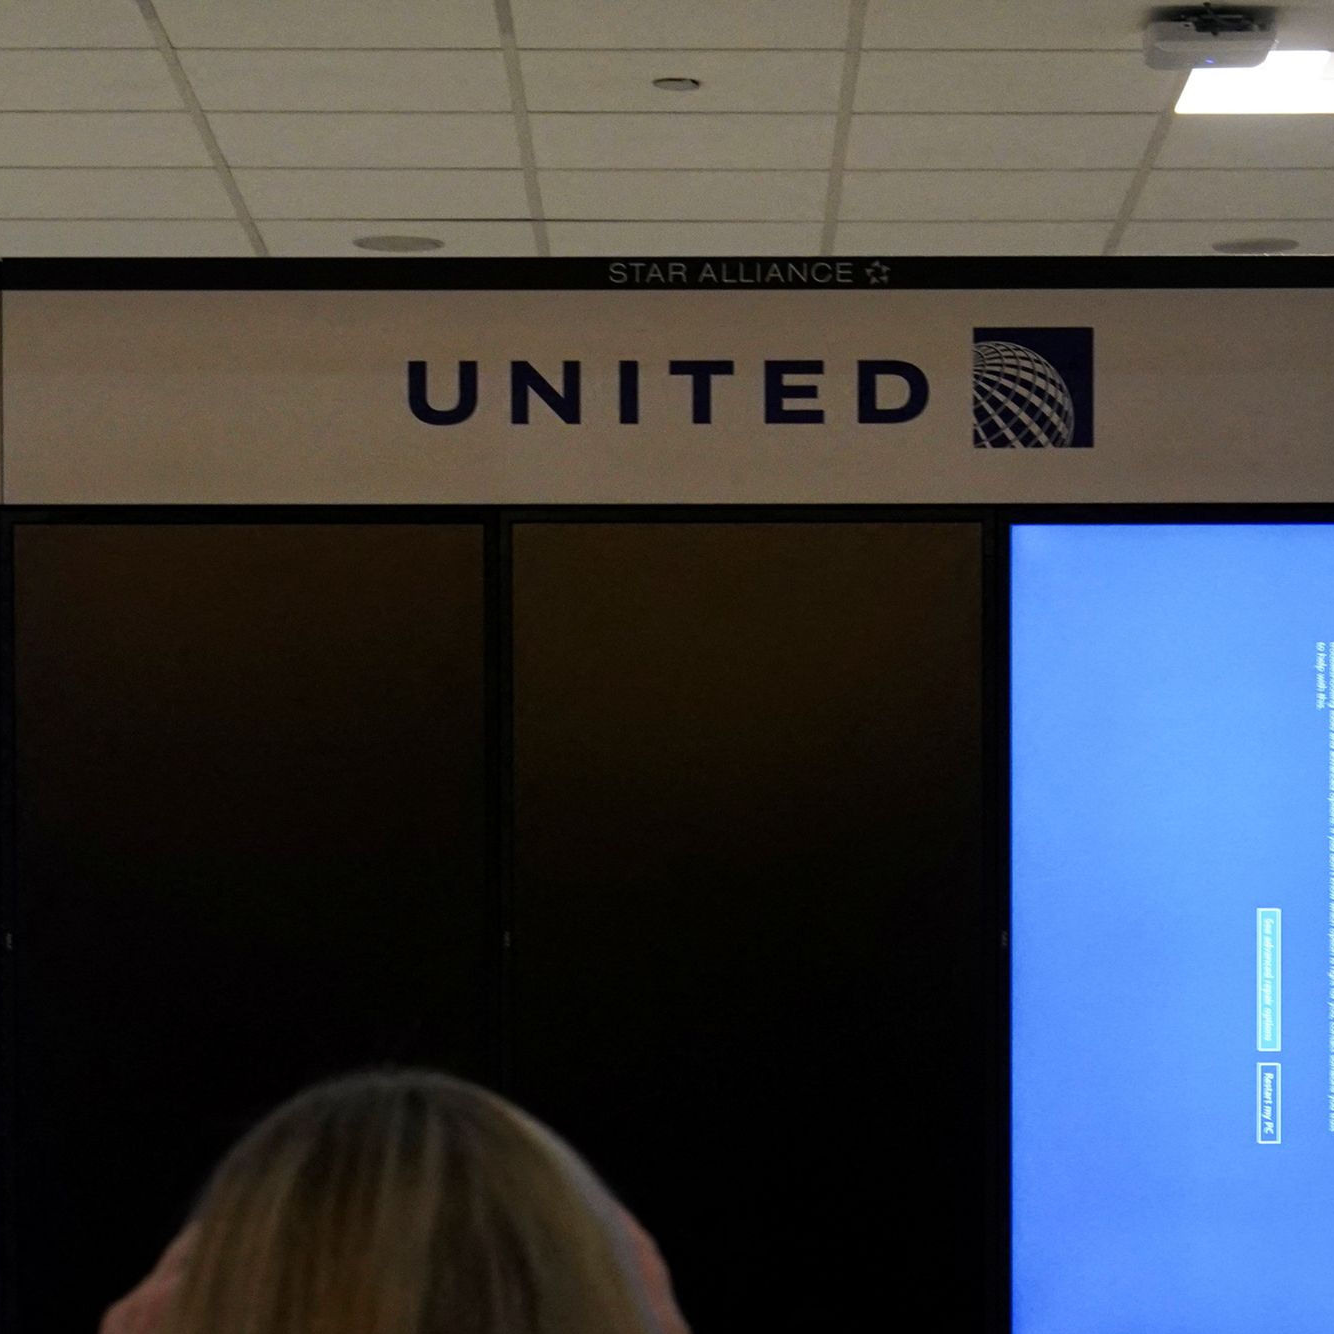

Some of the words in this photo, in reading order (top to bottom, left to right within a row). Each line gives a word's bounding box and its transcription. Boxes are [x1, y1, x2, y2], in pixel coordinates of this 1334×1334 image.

[609, 262, 687, 283] STAR
[699, 262, 852, 283] ALLIANCE
[408, 360, 929, 426] UNITED
[1264, 1072, 1274, 1104] Restart
